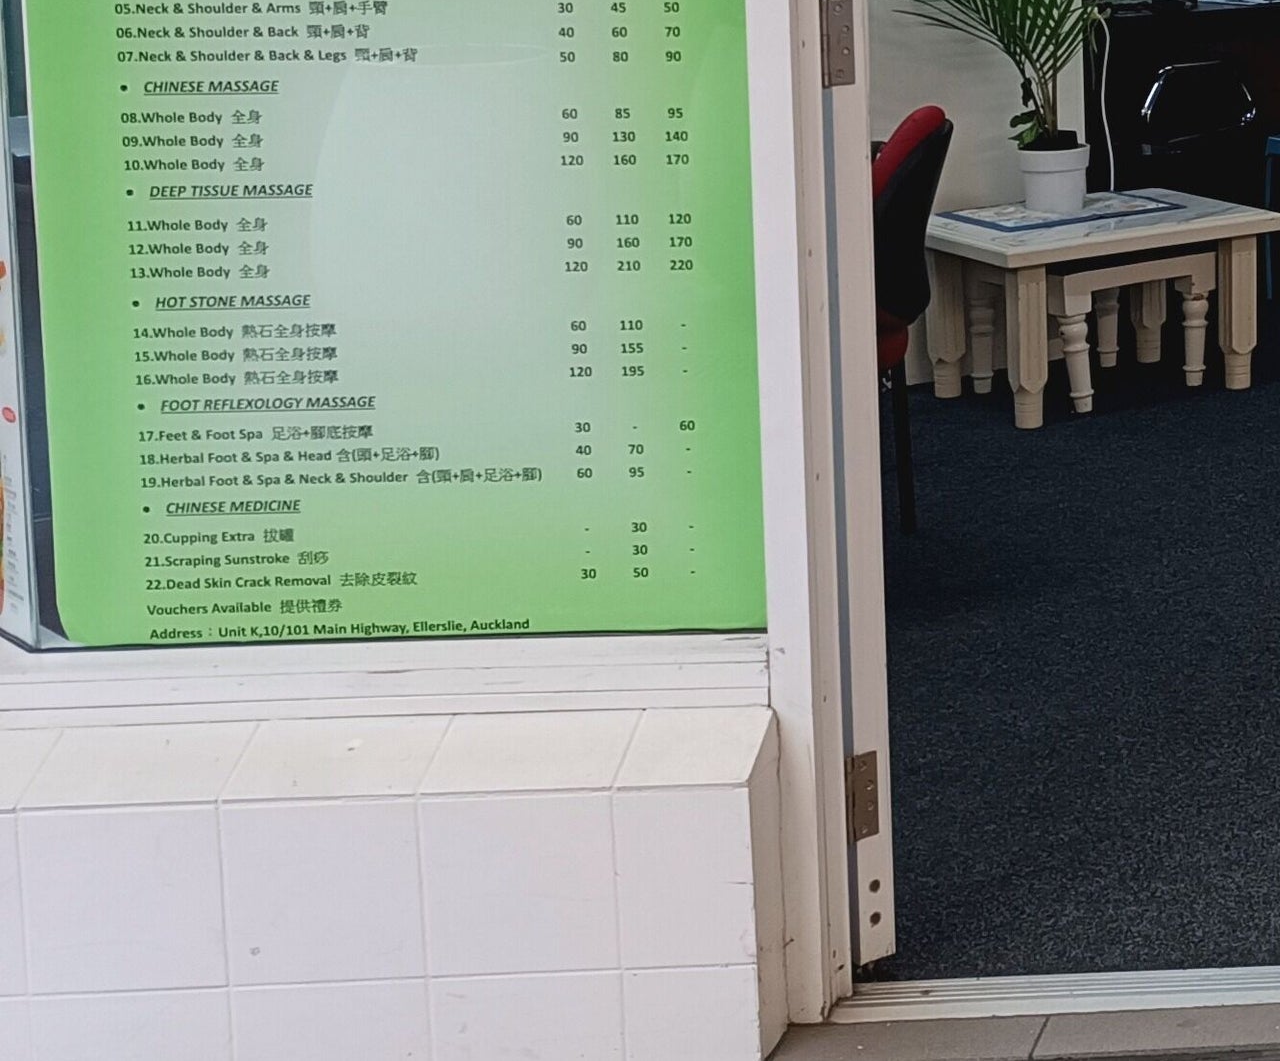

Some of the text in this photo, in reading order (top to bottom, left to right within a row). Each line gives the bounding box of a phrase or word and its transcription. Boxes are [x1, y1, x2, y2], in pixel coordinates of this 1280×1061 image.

[114, 2, 301, 15] 05.Neck Shoulder Arms
[116, 26, 299, 38] 06.Neck Shoulder Back
[117, 49, 347, 63] 07.Neck Shoulder Back Legs
[560, 51, 575, 63] 50
[613, 51, 629, 62] 80
[665, 51, 682, 62] 90
[144, 79, 279, 94] CHINESE MASSAGE
[120, 110, 262, 125] 08.Whole Body 全身
[122, 133, 263, 148] 09.Whole Body 全身
[563, 131, 579, 143] 90
[613, 131, 636, 142] 130
[665, 131, 688, 142] 140
[150, 183, 313, 198] DEEP TISSUE MASSAGE
[128, 217, 268, 232] 11.Whole Body 全身
[155, 294, 311, 309] HOT STONE MASSAGE
[571, 320, 587, 331] 60
[620, 320, 643, 331] 110
[133, 327, 196, 339] 14.Whole
[200, 326, 234, 339] Body
[160, 396, 376, 412] FOOT REFLEXOLOGY MASSAGE
[139, 429, 263, 442] 17.Feet Foot Spa
[140, 450, 332, 465] 18.Herbal Foot Spa Head
[577, 468, 593, 478] 60
[629, 466, 645, 478] 95
[141, 472, 409, 488] 19.Herbal Foot Spa Neck Shoulder
[166, 500, 301, 515] CHINESE MEDICINE
[144, 531, 255, 545] 20.Cupping Extra
[145, 555, 221, 568] 21.Scraping
[224, 553, 290, 565] Sunstroke
[581, 568, 597, 579] 30
[633, 567, 649, 578] 50
[146, 578, 201, 590] 22.Dead
[204, 577, 232, 589] Skin
[235, 576, 271, 588] Crack
[275, 575, 331, 586] Removal
[147, 604, 208, 615] Vouchers
[211, 601, 272, 613] Available
[150, 619, 529, 640] Address Unit K,10/101 Main Highway, Ellerslie, Auckland
